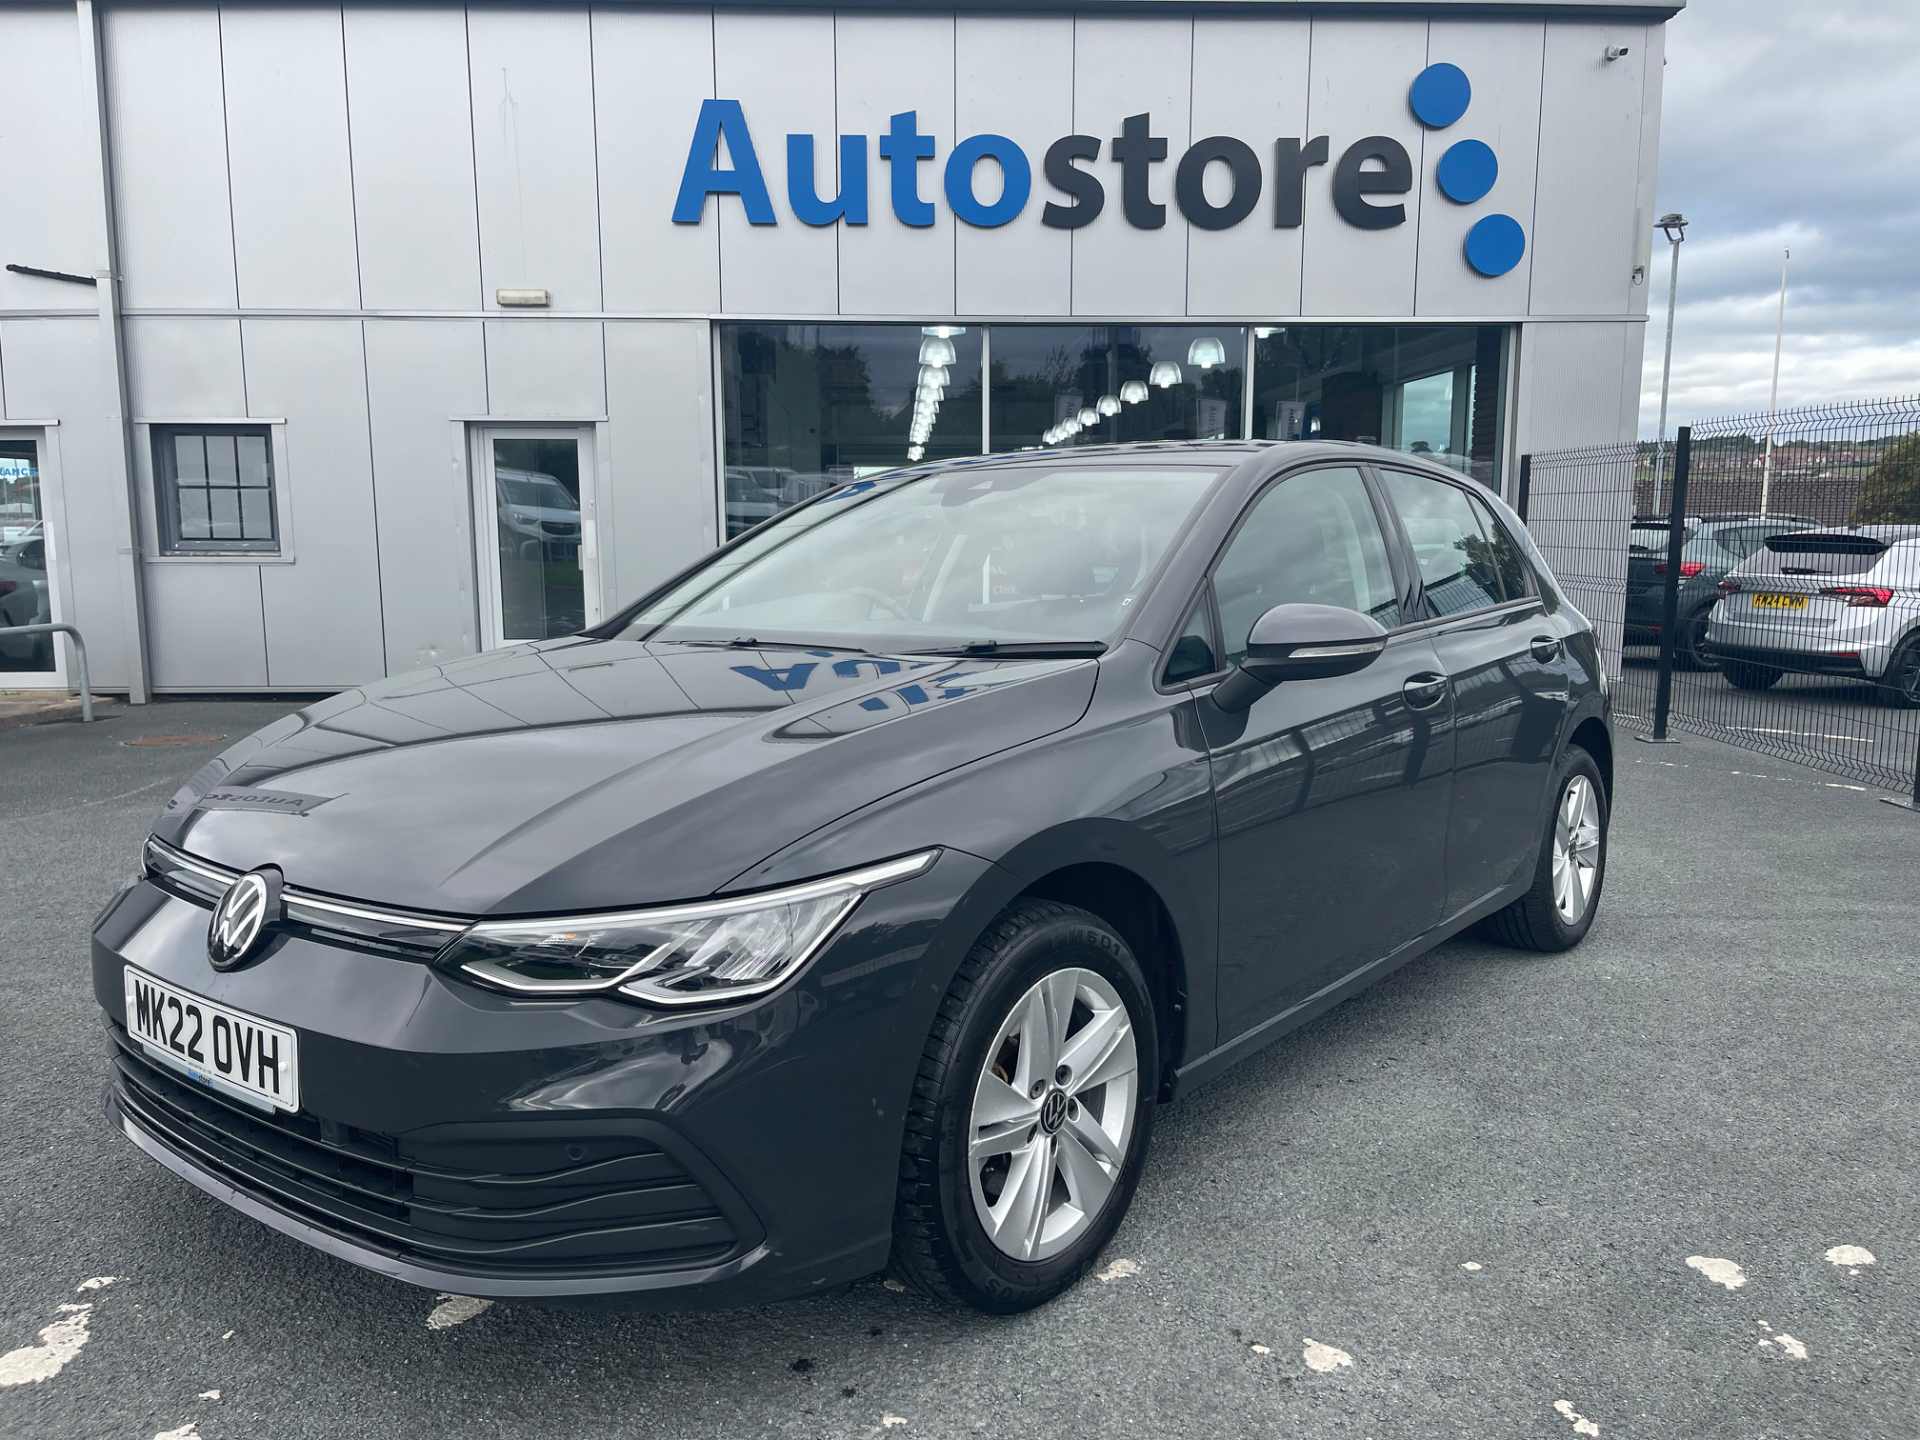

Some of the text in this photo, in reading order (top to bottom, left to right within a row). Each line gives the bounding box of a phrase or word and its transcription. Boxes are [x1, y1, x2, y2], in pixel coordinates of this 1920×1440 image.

[672, 98, 1413, 229] Autostore
[134, 979, 280, 1095] MK22 OVH
